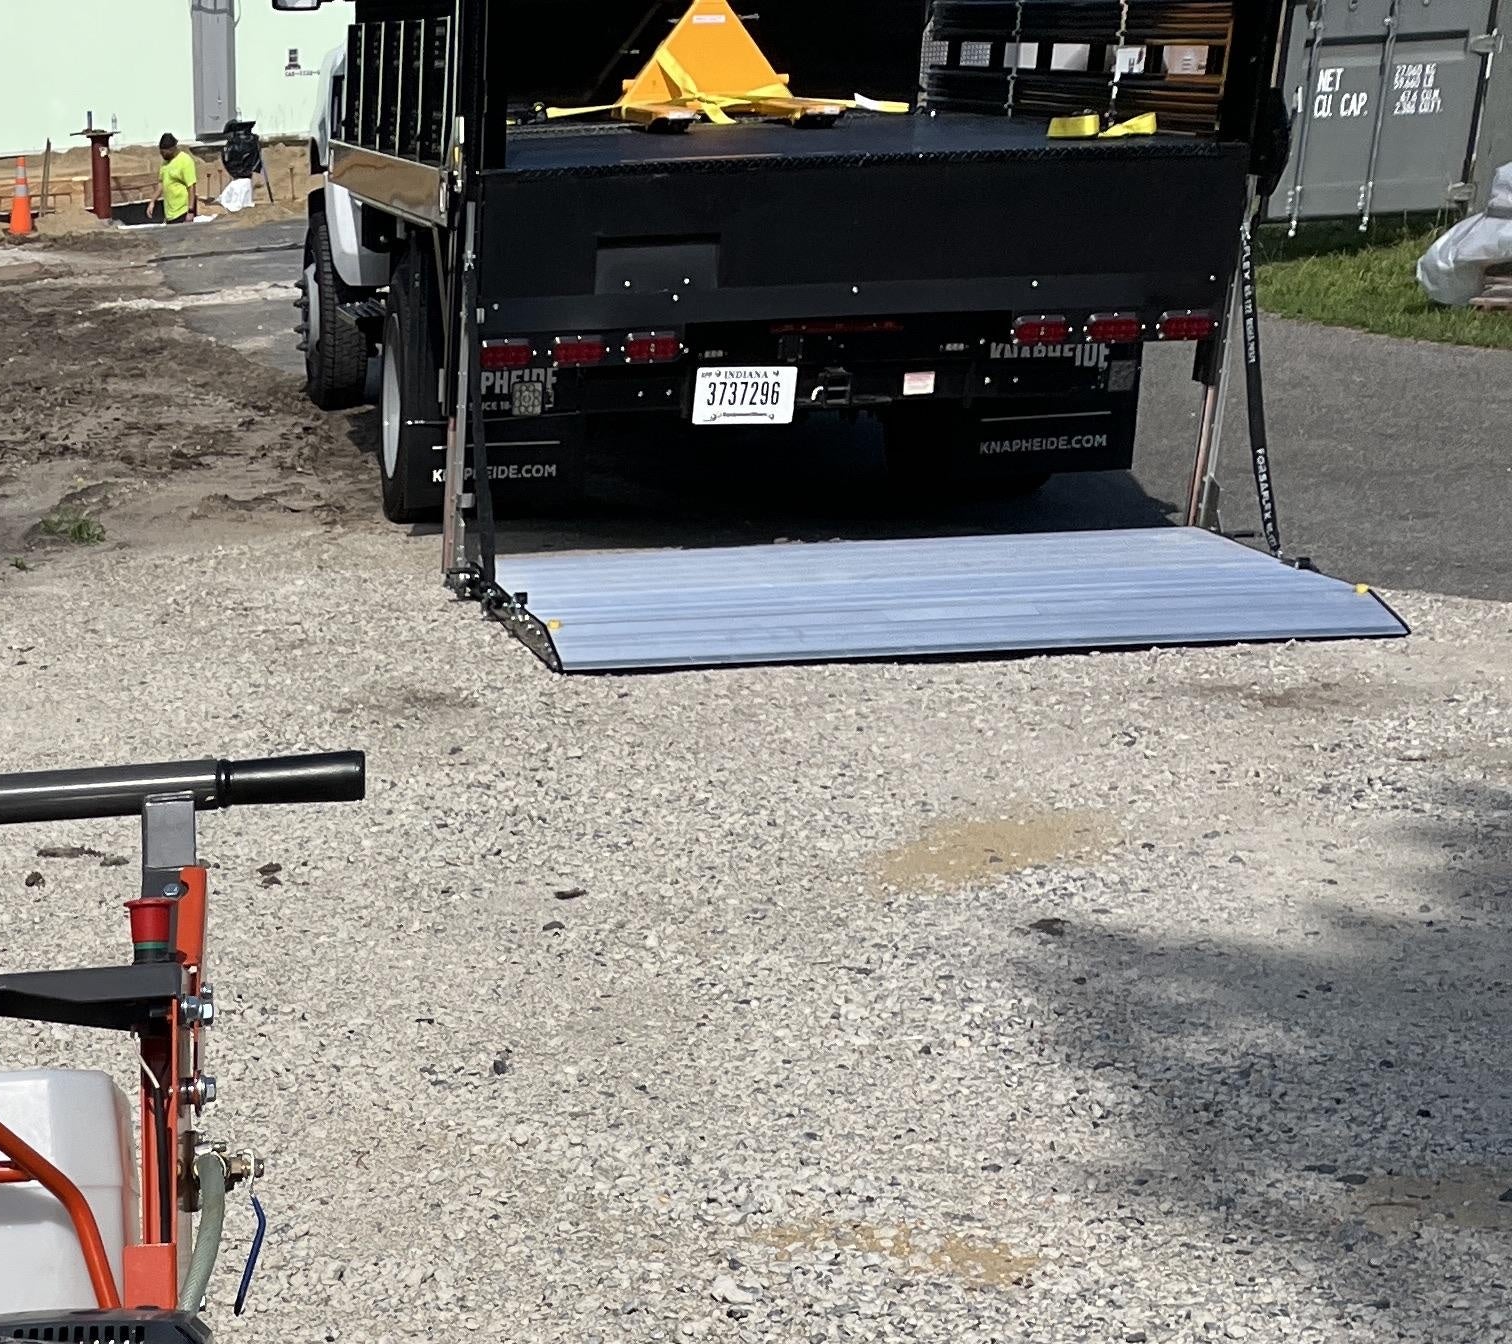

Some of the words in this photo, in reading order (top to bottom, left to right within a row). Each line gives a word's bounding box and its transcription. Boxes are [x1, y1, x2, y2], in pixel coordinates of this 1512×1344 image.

[1317, 68, 1344, 92] NET
[1313, 94, 1333, 118] CU.
[1340, 92, 1368, 116] CAP.
[724, 370, 769, 379] INDIANA
[707, 381, 781, 406] 3737296
[979, 434, 1107, 454] KNAPHEIDE.COM
